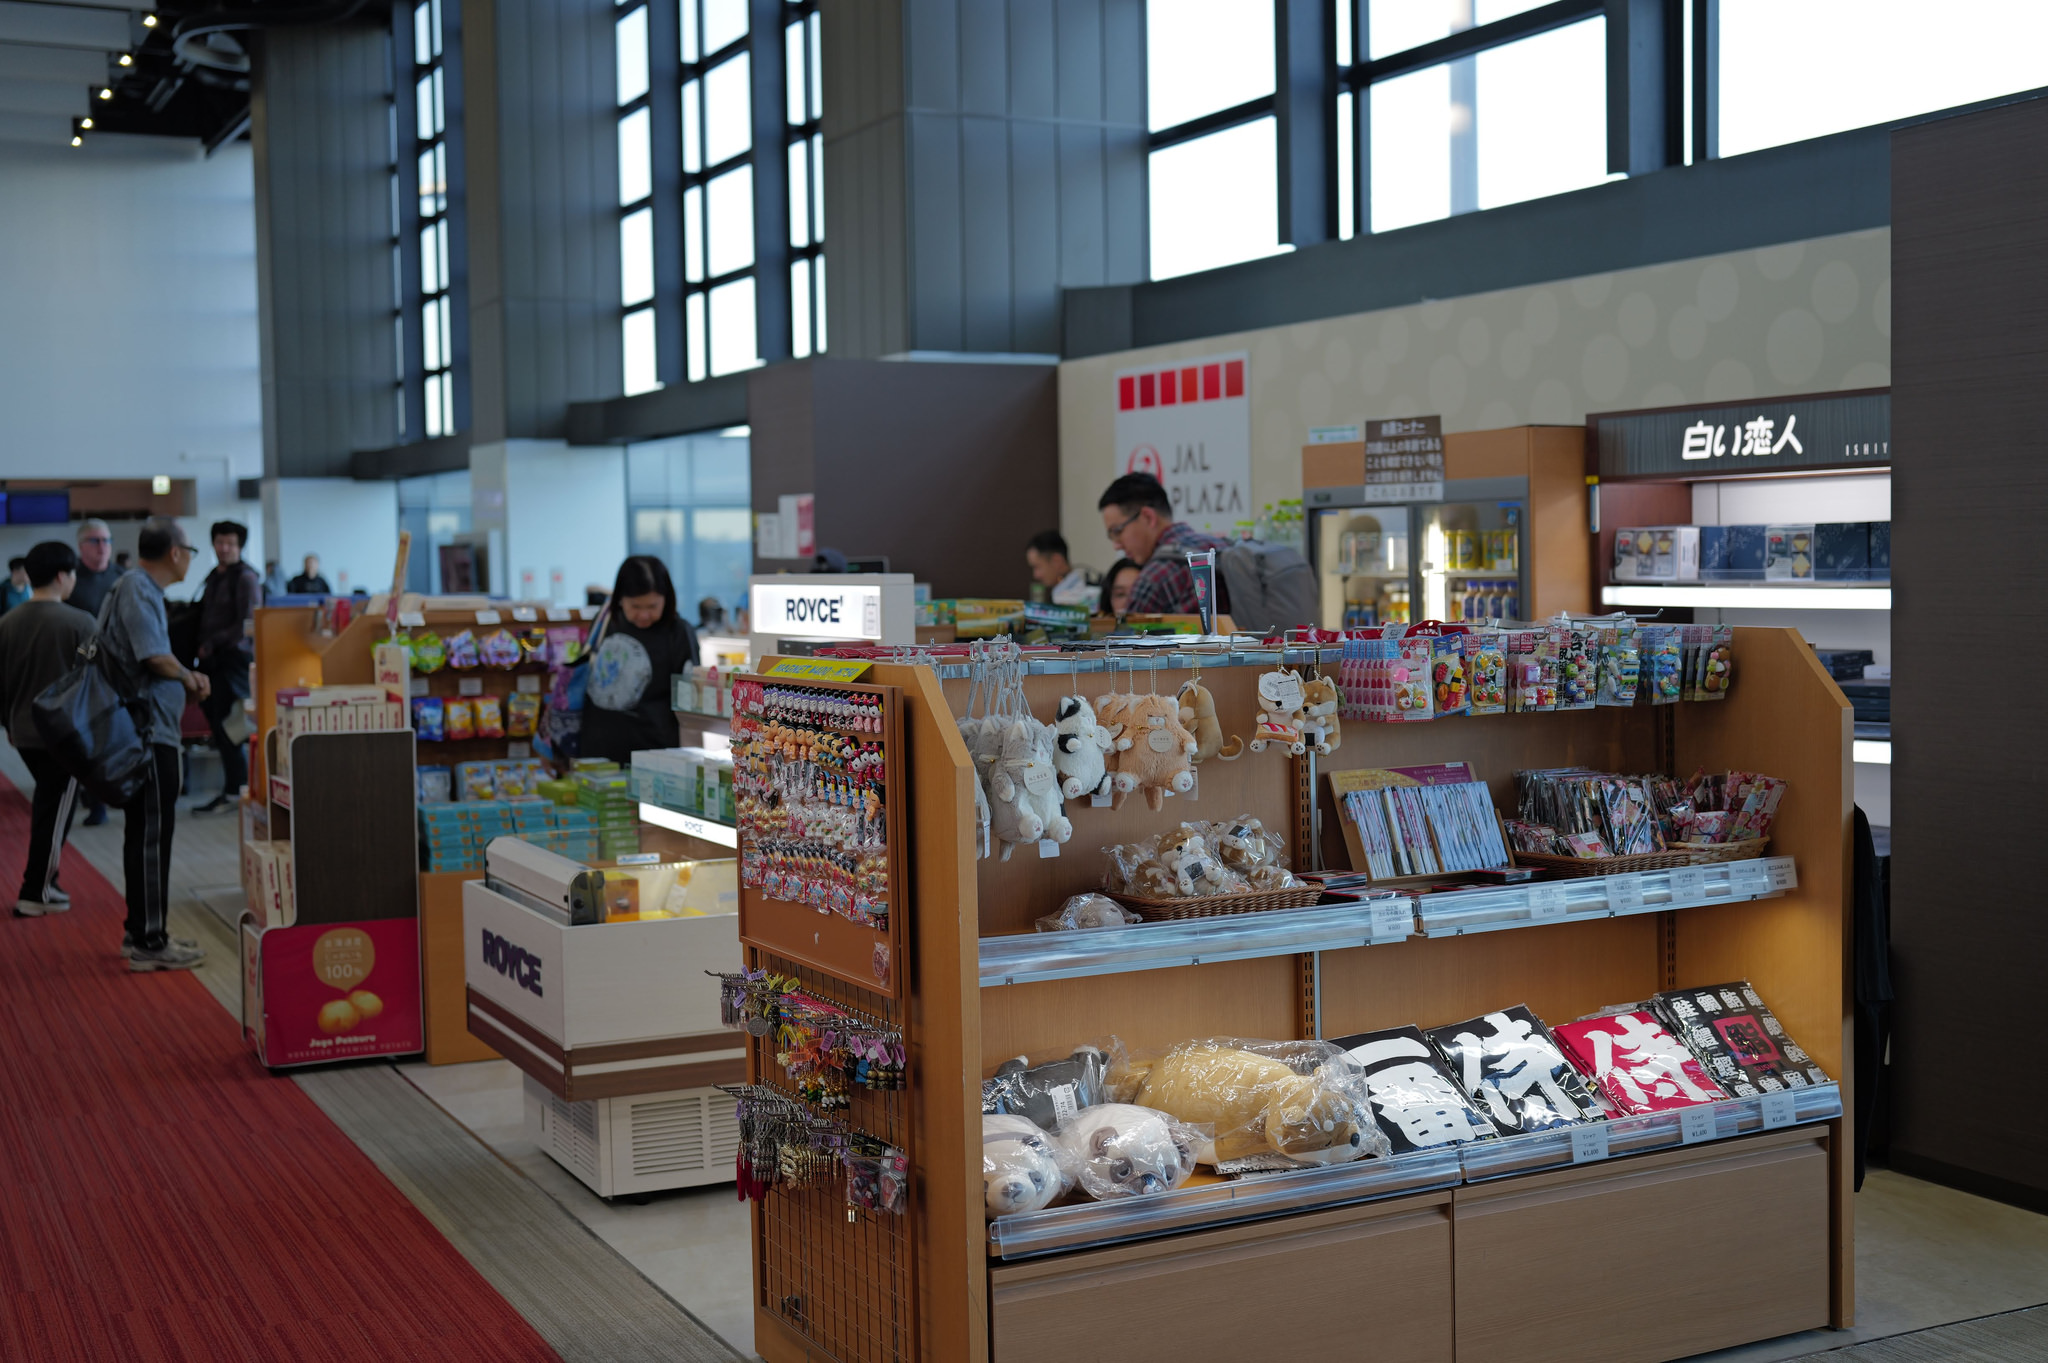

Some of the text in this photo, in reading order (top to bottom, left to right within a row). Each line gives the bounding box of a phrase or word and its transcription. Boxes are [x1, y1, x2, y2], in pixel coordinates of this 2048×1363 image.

[1172, 442, 1210, 474] JAL
[1682, 414, 1804, 461] 白い恋人
[1172, 482, 1243, 515] PLAZA
[324, 964, 364, 980] 100%
[482, 927, 543, 998] ROYCE
[1451, 1012, 1583, 1130] 侍
[1582, 1014, 1714, 1102] 侍
